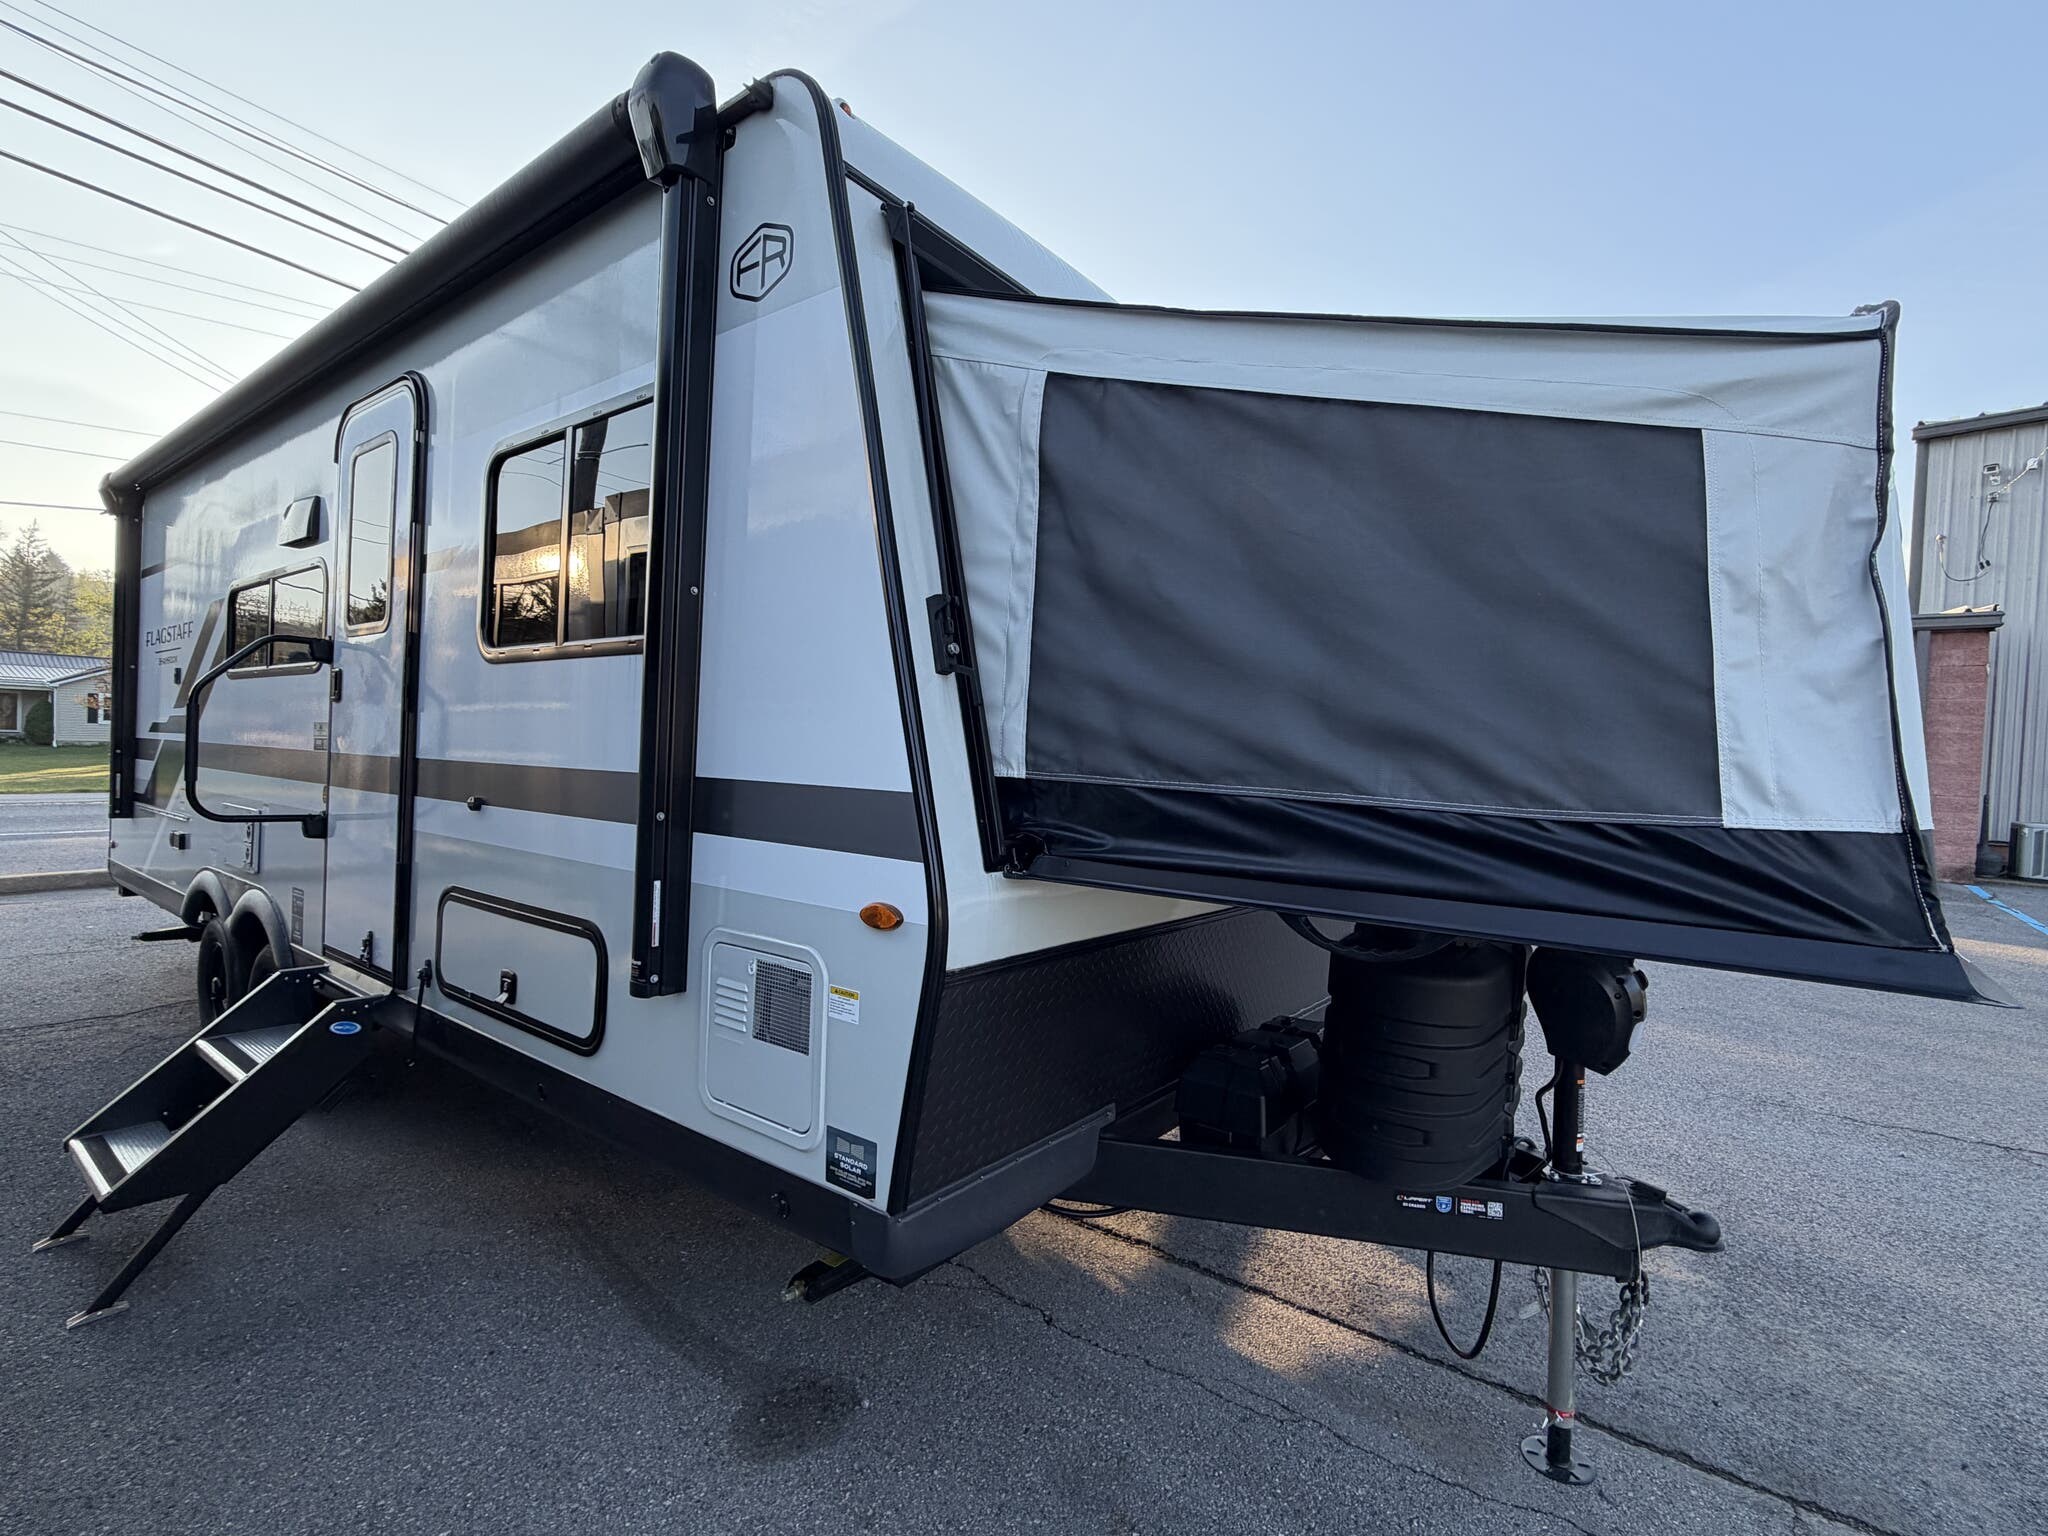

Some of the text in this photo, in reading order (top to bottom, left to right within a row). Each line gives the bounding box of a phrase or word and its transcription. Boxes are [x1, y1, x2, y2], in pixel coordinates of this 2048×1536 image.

[737, 233, 787, 290] FR
[145, 620, 194, 647] FLAGSTAFF
[834, 1152, 868, 1171] STANDARD
[840, 1161, 862, 1175] SOLAR
